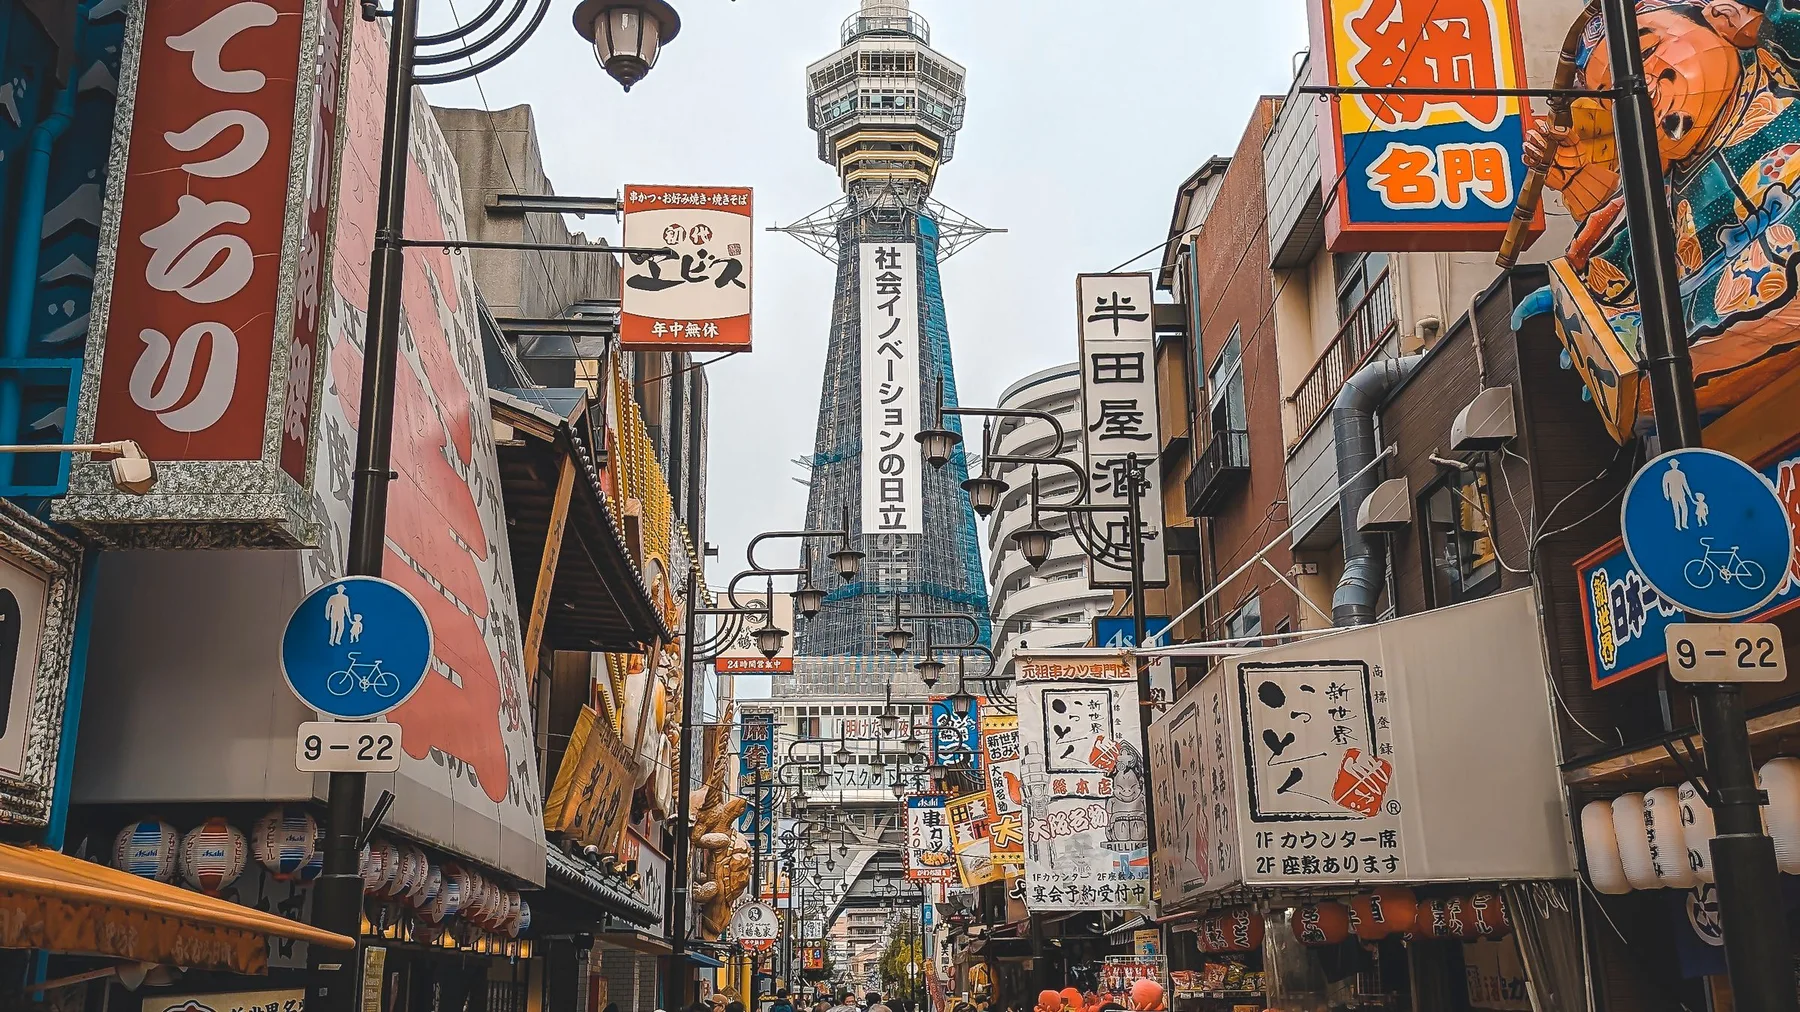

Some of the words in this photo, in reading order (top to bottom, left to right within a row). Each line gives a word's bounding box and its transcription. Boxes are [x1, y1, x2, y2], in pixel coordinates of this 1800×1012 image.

[1372, 148, 1507, 203] 名門
[629, 190, 748, 206] 串かつ・お好み焼き・焼きそば
[663, 224, 713, 246] 初代
[626, 247, 747, 291] エビス
[652, 321, 720, 339] 年中無休
[873, 246, 908, 530] 社会イノベーションの日立
[1087, 291, 1153, 562] 半田屋酒店
[1593, 572, 1615, 666] 新世界
[1022, 663, 1131, 679] 元祖串カツ専門店
[1088, 699, 1104, 735] 新世界
[1325, 682, 1358, 746] 新世界
[1372, 665, 1394, 755] 商標登録
[742, 716, 770, 769] 麻雀
[1257, 680, 1330, 805] いっとく
[917, 798, 938, 807] Asahi
[991, 765, 1008, 813] 大阪名物
[1052, 778, 1113, 796] 総本店
[266, 819, 278, 861] アサヒビール
[285, 834, 306, 842] Asahi
[922, 809, 943, 852] 串カツ
[1029, 804, 1110, 842] 大阪名物
[1256, 831, 1274, 848] 1F
[1280, 830, 1397, 849] カウンター席
[134, 849, 157, 857] Asahi
[159, 832, 176, 877] アサヒビール
[185, 834, 197, 876] アサヒビール
[202, 850, 224, 858] Asahi
[229, 834, 243, 876] アサヒビール
[1256, 857, 1276, 874] 2F
[1282, 855, 1400, 875] 座敷あります
[1032, 883, 1146, 903] 宴会予約受付中
[1473, 895, 1493, 934] ビール
